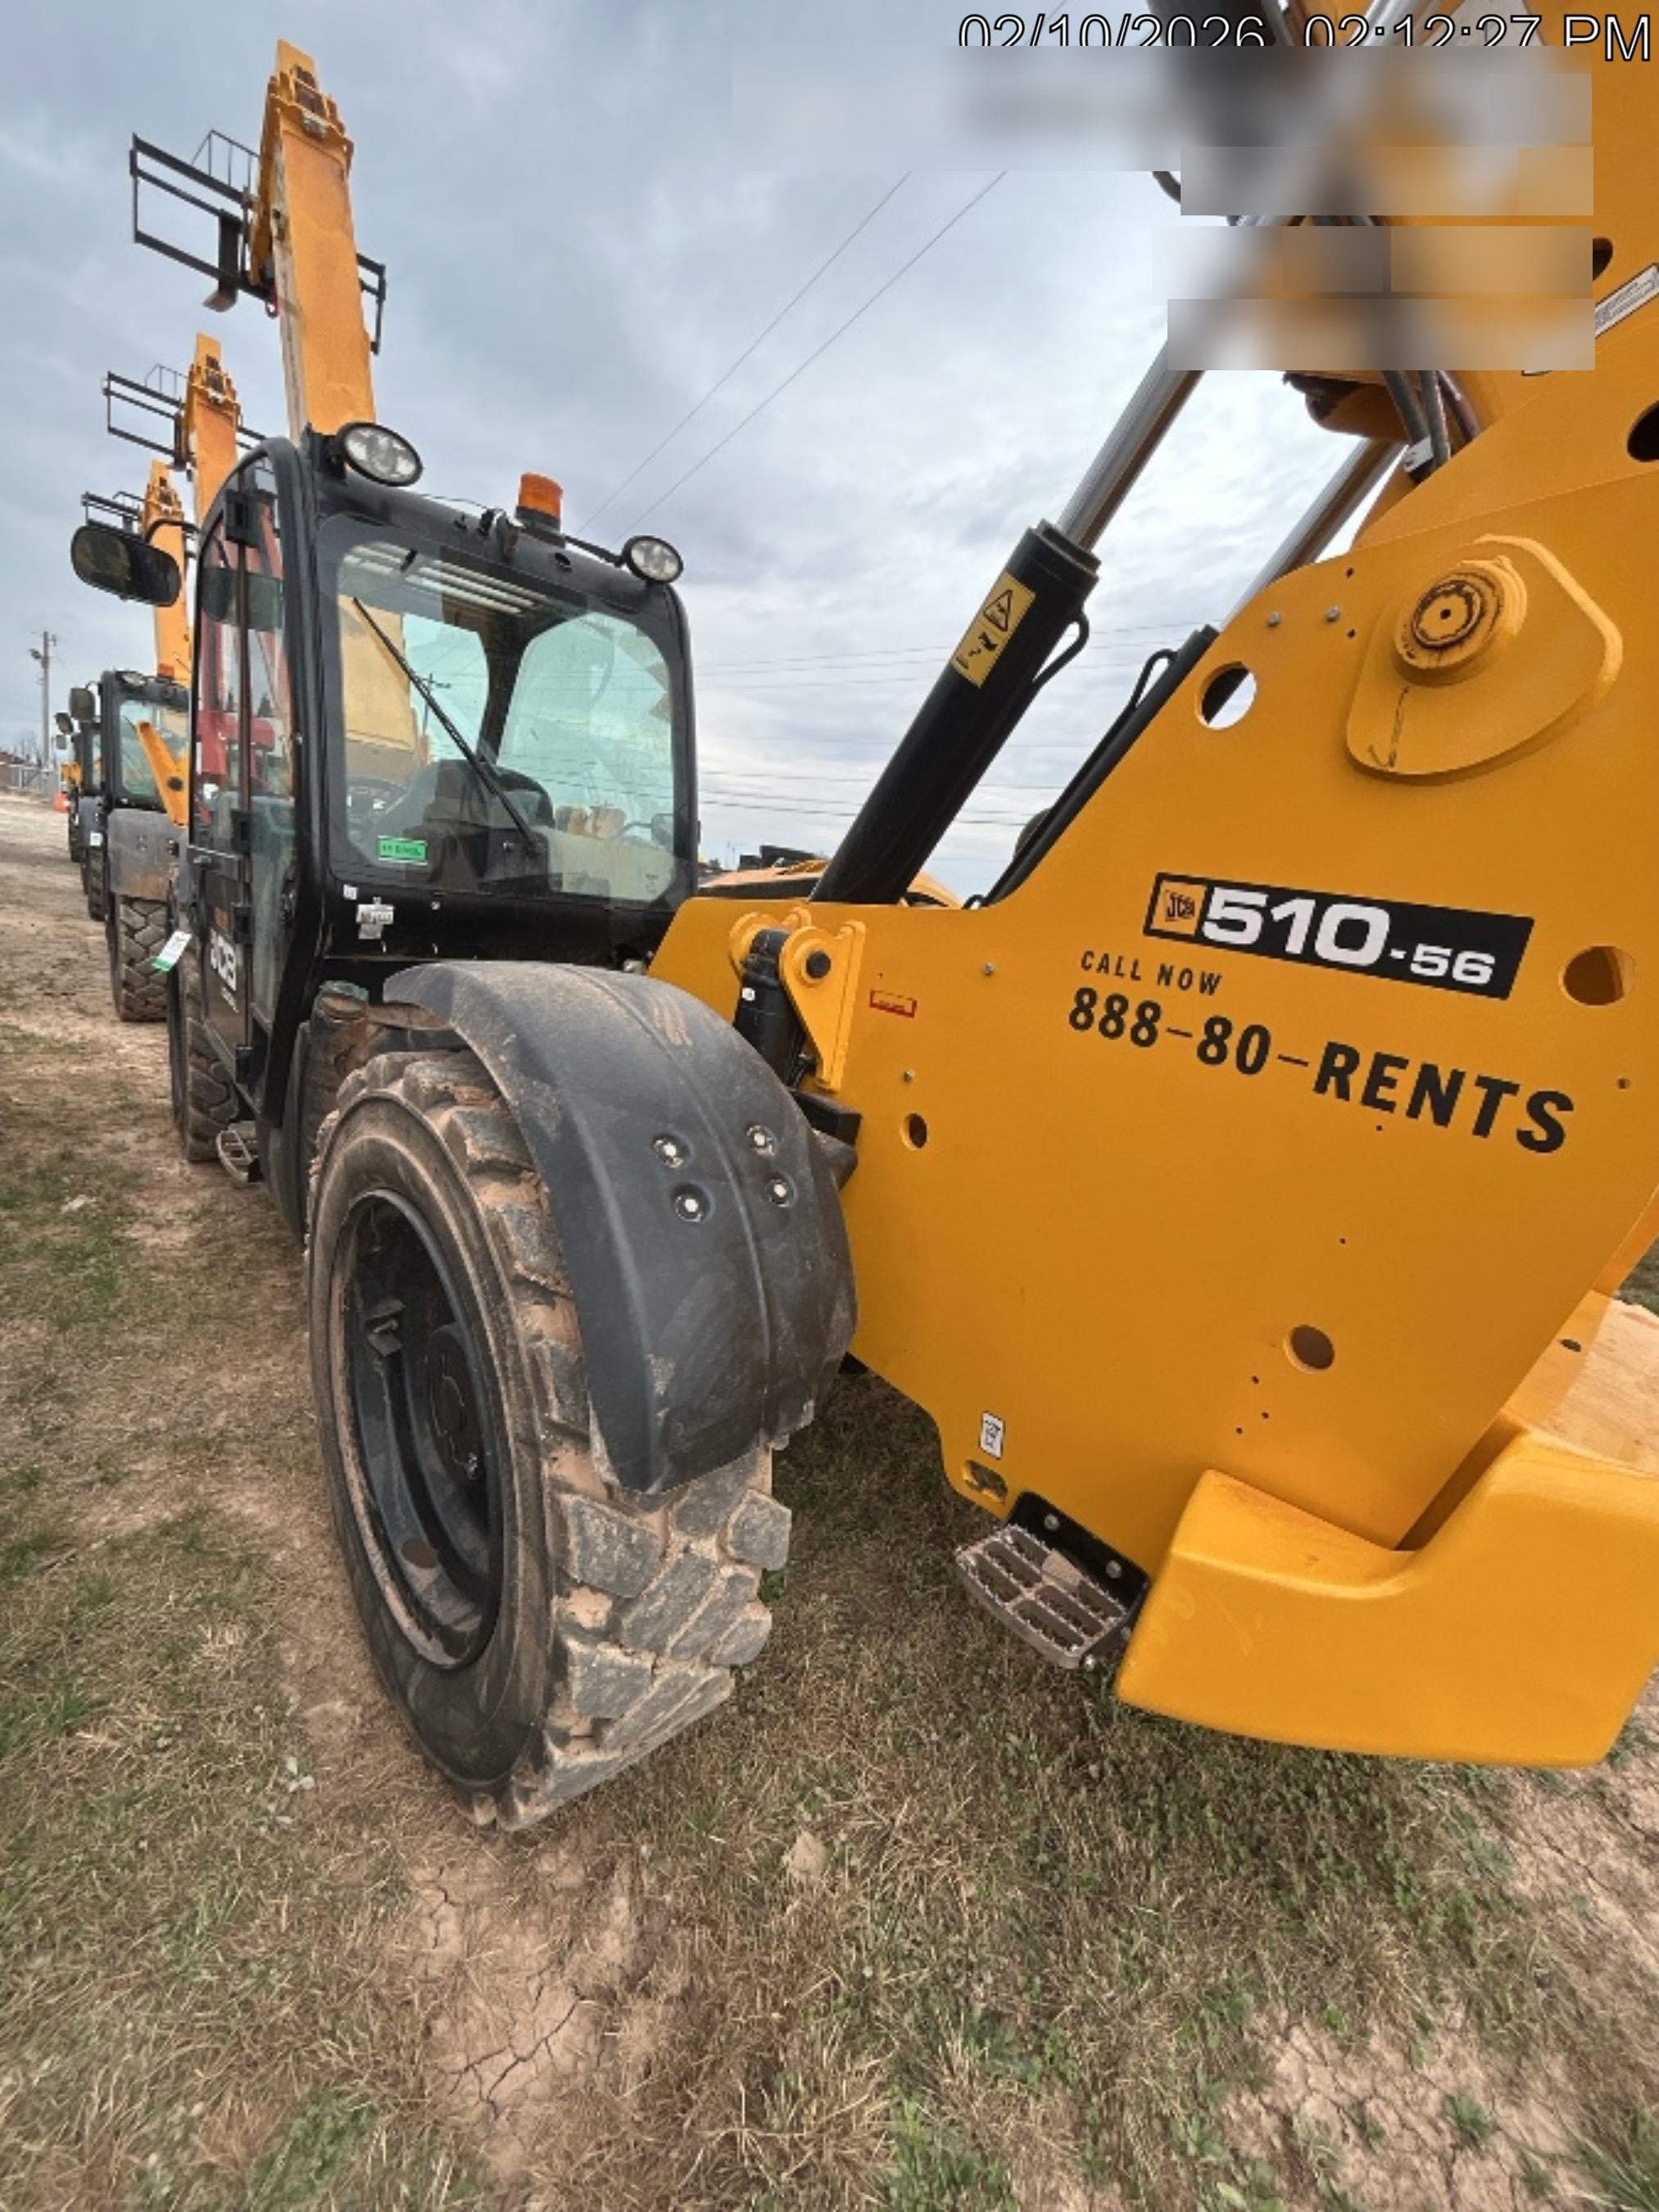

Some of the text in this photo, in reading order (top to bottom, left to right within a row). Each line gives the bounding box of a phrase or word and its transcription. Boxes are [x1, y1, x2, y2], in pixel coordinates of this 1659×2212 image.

[1081, 950, 1223, 996] CALL NOW
[1201, 886, 1497, 986] 510-56
[1068, 986, 1575, 1154] 888-80-RENTS
